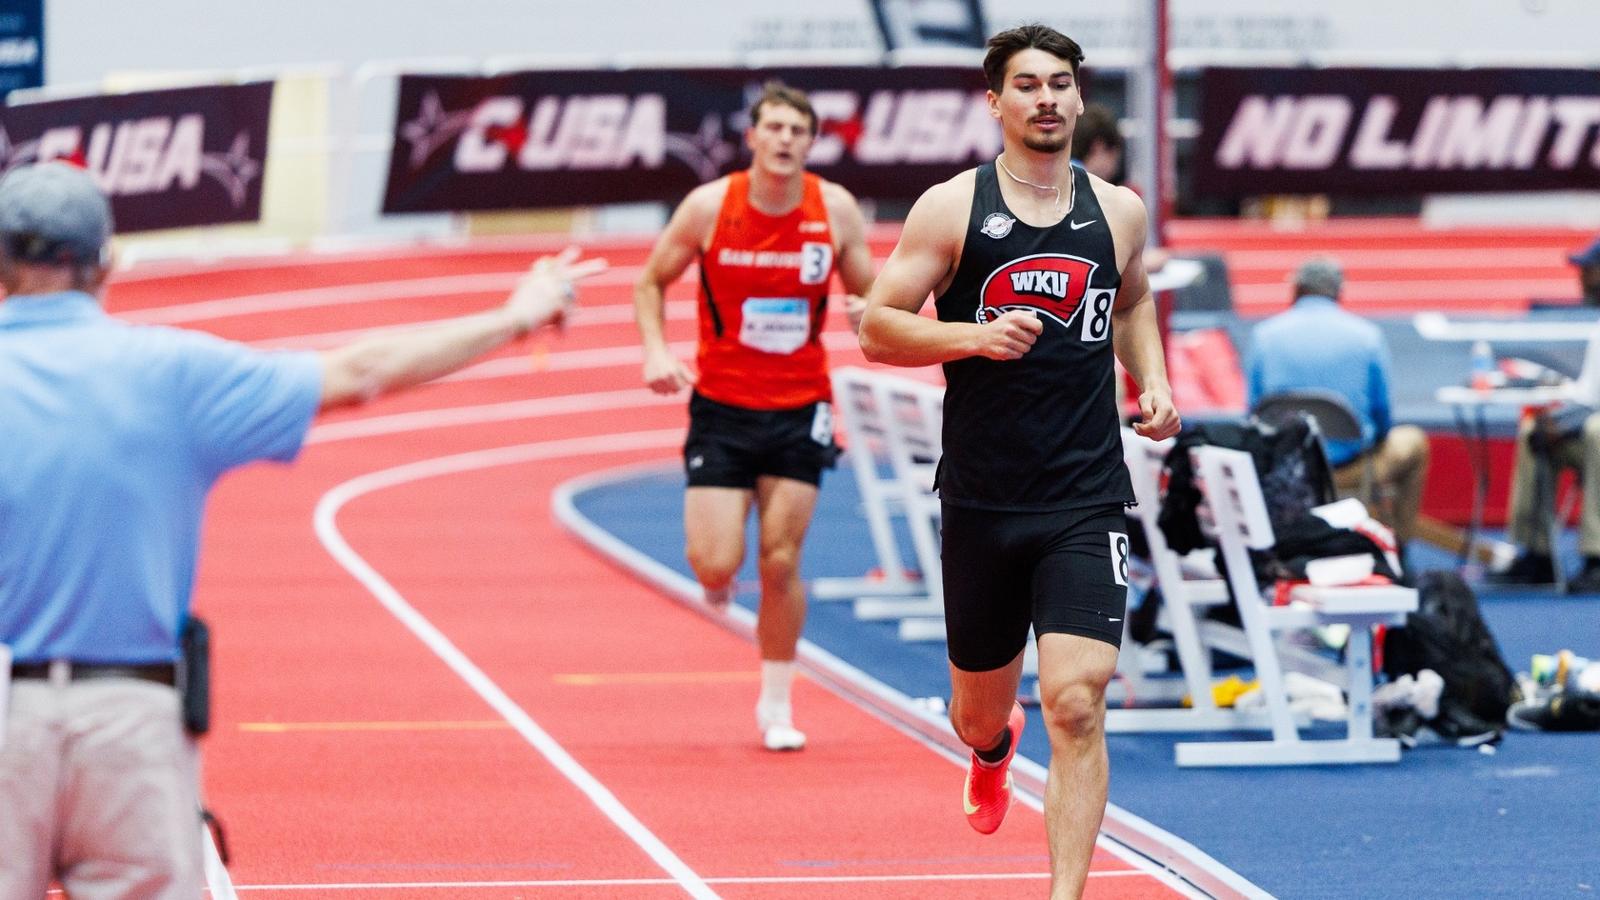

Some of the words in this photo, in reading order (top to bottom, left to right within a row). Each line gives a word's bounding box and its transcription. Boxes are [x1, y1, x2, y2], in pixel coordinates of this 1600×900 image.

[1214, 95, 1353, 169] NO
[807, 246, 824, 281] 3
[1010, 270, 1070, 299] WKU
[1089, 291, 1112, 339] 8
[1116, 536, 1129, 584] 8
